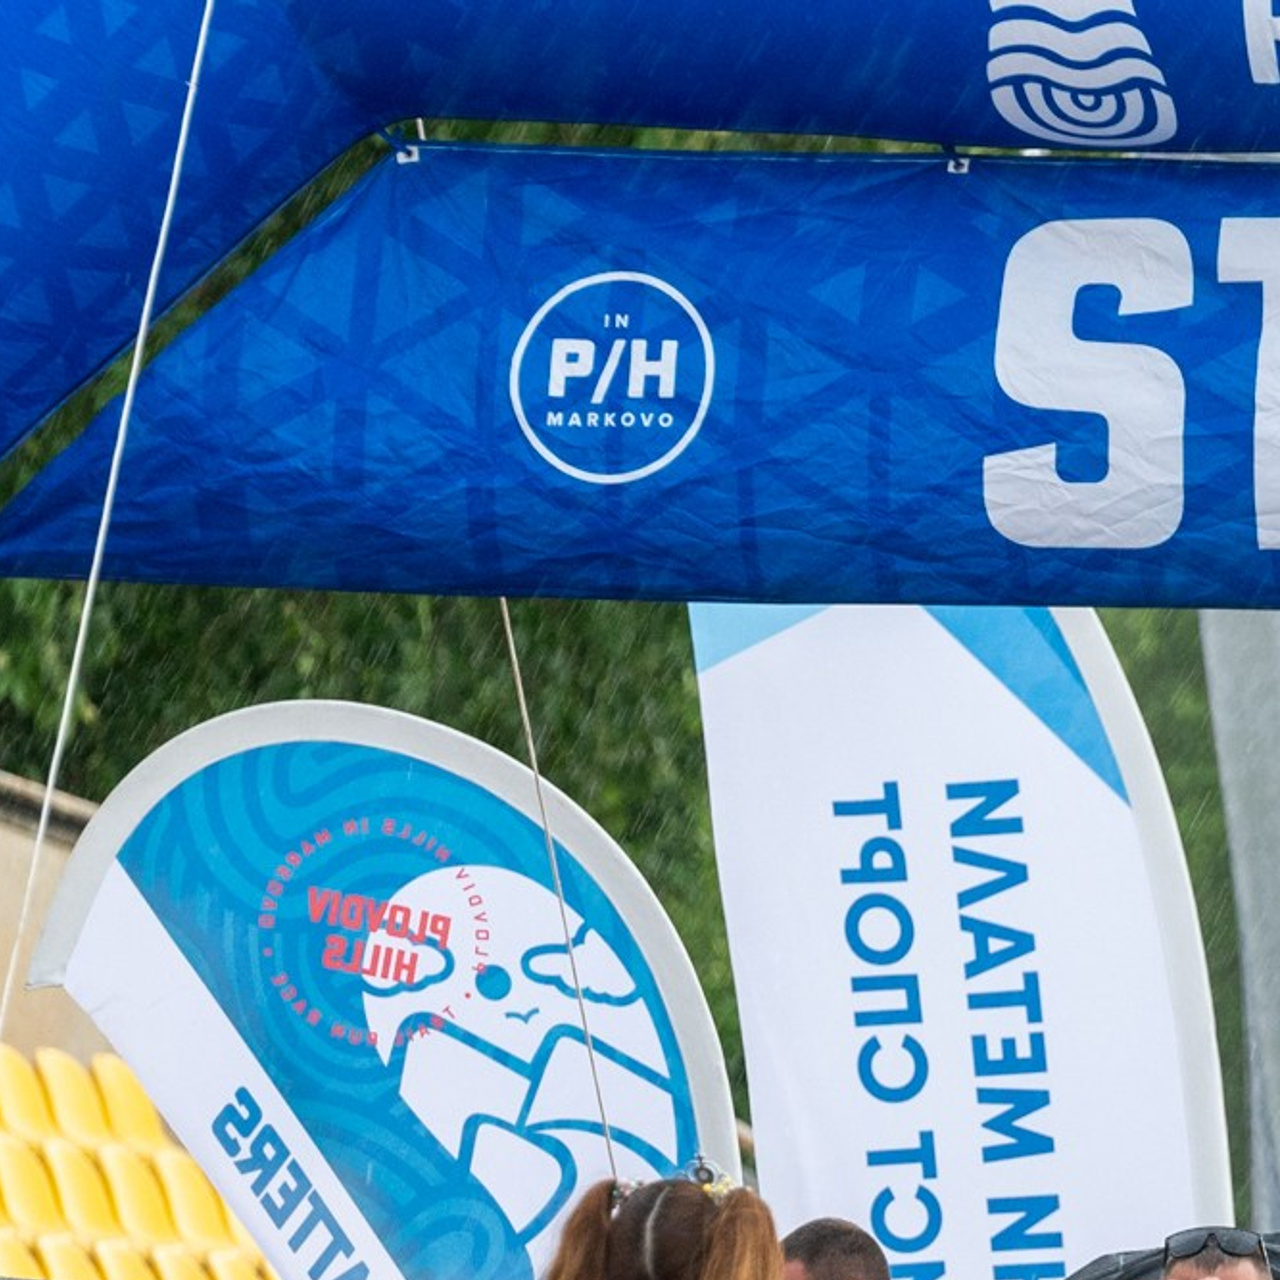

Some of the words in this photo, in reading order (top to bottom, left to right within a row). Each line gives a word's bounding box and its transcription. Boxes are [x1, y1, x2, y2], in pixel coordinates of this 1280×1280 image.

[604, 314, 629, 328] IN
[548, 338, 679, 404] P/H
[546, 411, 674, 428] MARKOVO
